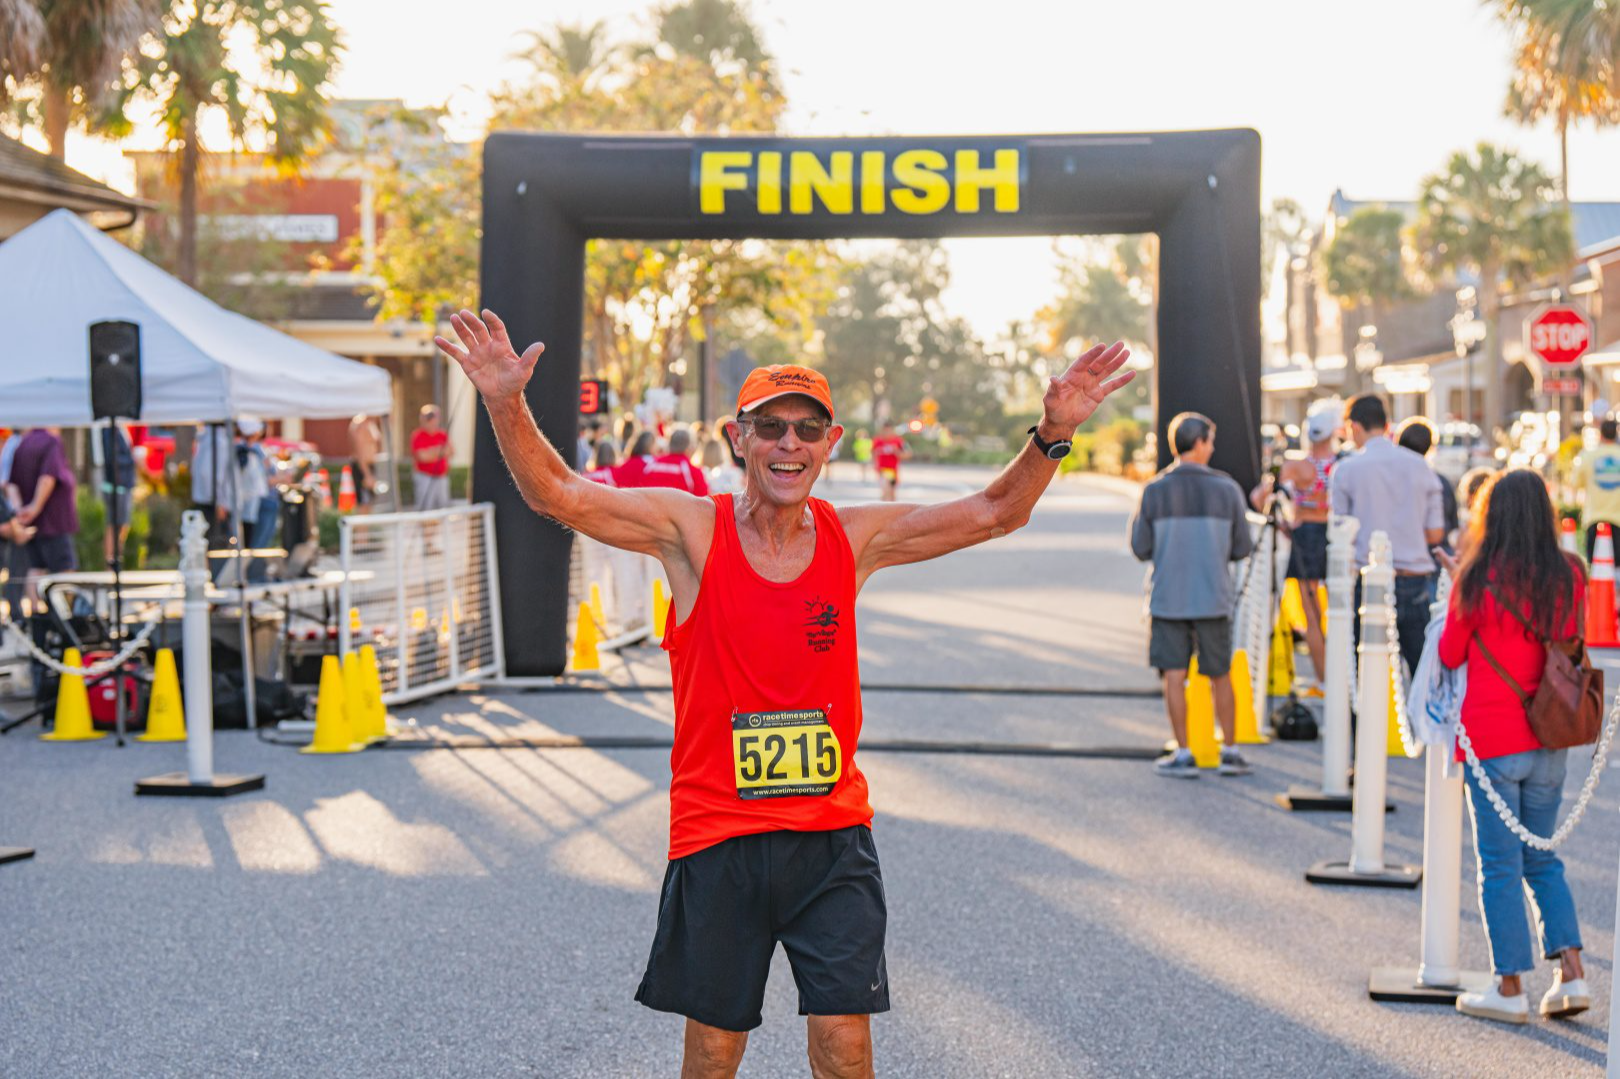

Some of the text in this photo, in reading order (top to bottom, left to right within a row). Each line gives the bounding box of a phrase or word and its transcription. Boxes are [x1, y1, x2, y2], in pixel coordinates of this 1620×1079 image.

[701, 150, 1019, 214] FINISH
[1535, 323, 1586, 351] STOP
[580, 381, 599, 414] 3
[740, 732, 837, 782] 5215
[753, 786, 829, 796] www.racetimesports.com
